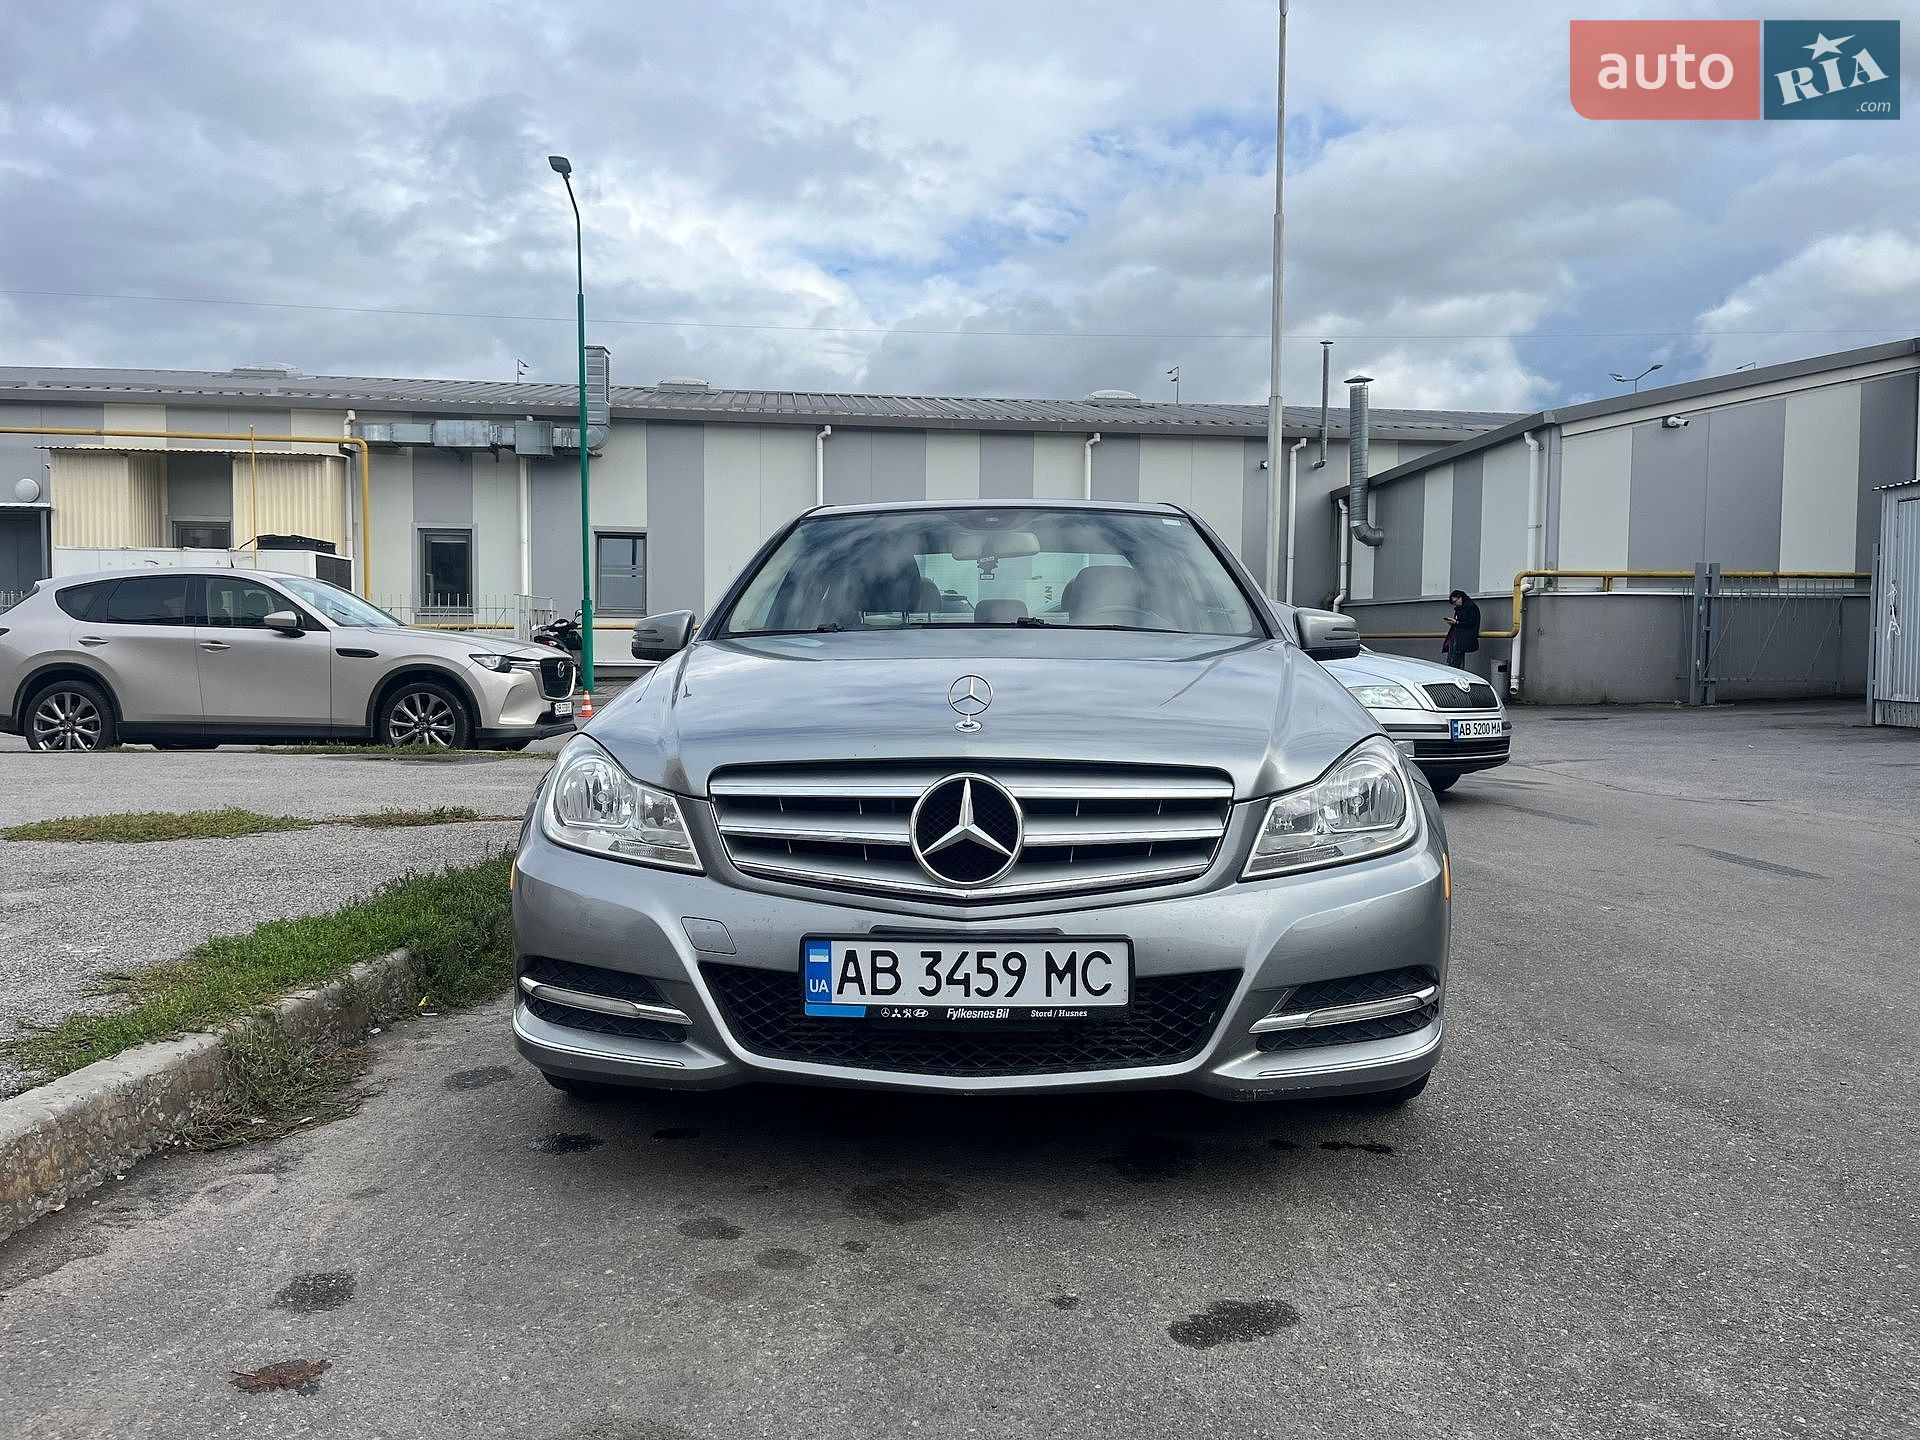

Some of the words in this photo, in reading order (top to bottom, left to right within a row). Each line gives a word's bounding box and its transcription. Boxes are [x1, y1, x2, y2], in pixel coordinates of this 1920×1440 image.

[1460, 723, 1471, 736] AB
[1473, 722, 1490, 735] 5200
[836, 949, 902, 996] AB
[917, 950, 1027, 998] 3459
[1045, 950, 1113, 997] MC
[809, 979, 829, 994] UA
[1030, 1009, 1053, 1018] Stord
[1058, 1009, 1088, 1017] Husnes
